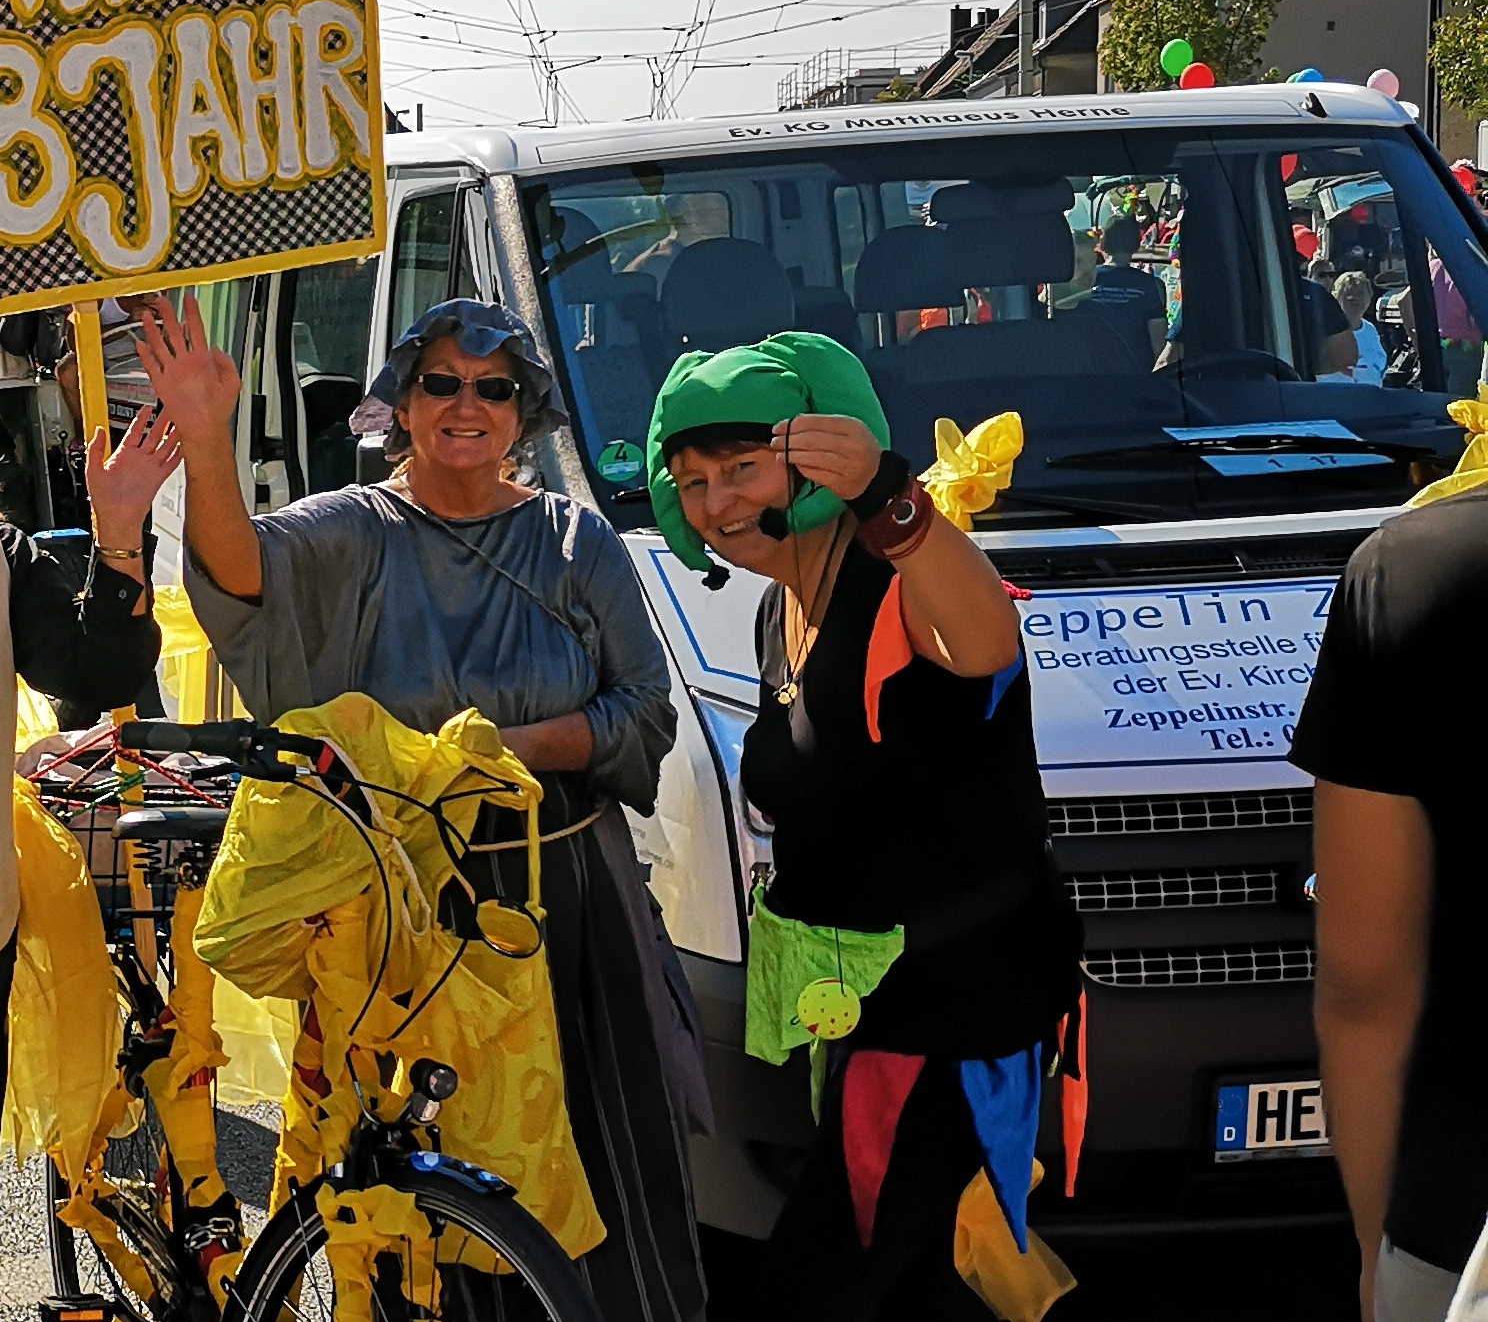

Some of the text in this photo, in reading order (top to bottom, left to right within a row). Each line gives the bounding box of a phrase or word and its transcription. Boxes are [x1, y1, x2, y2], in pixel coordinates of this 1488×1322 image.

[728, 126, 772, 138] Ev.
[845, 109, 1020, 129] Matthaeus
[1029, 106, 1131, 119] Herne
[1023, 591, 1272, 642] eppelin
[1034, 634, 1298, 670] Beratungsstelle
[1112, 674, 1169, 696] der
[1178, 669, 1232, 691] Ev.
[1104, 702, 1296, 731] Zeppelinstr.
[1201, 727, 1275, 751] Tel.:
[1255, 1087, 1321, 1143] HE
[1223, 1126, 1236, 1142] D
